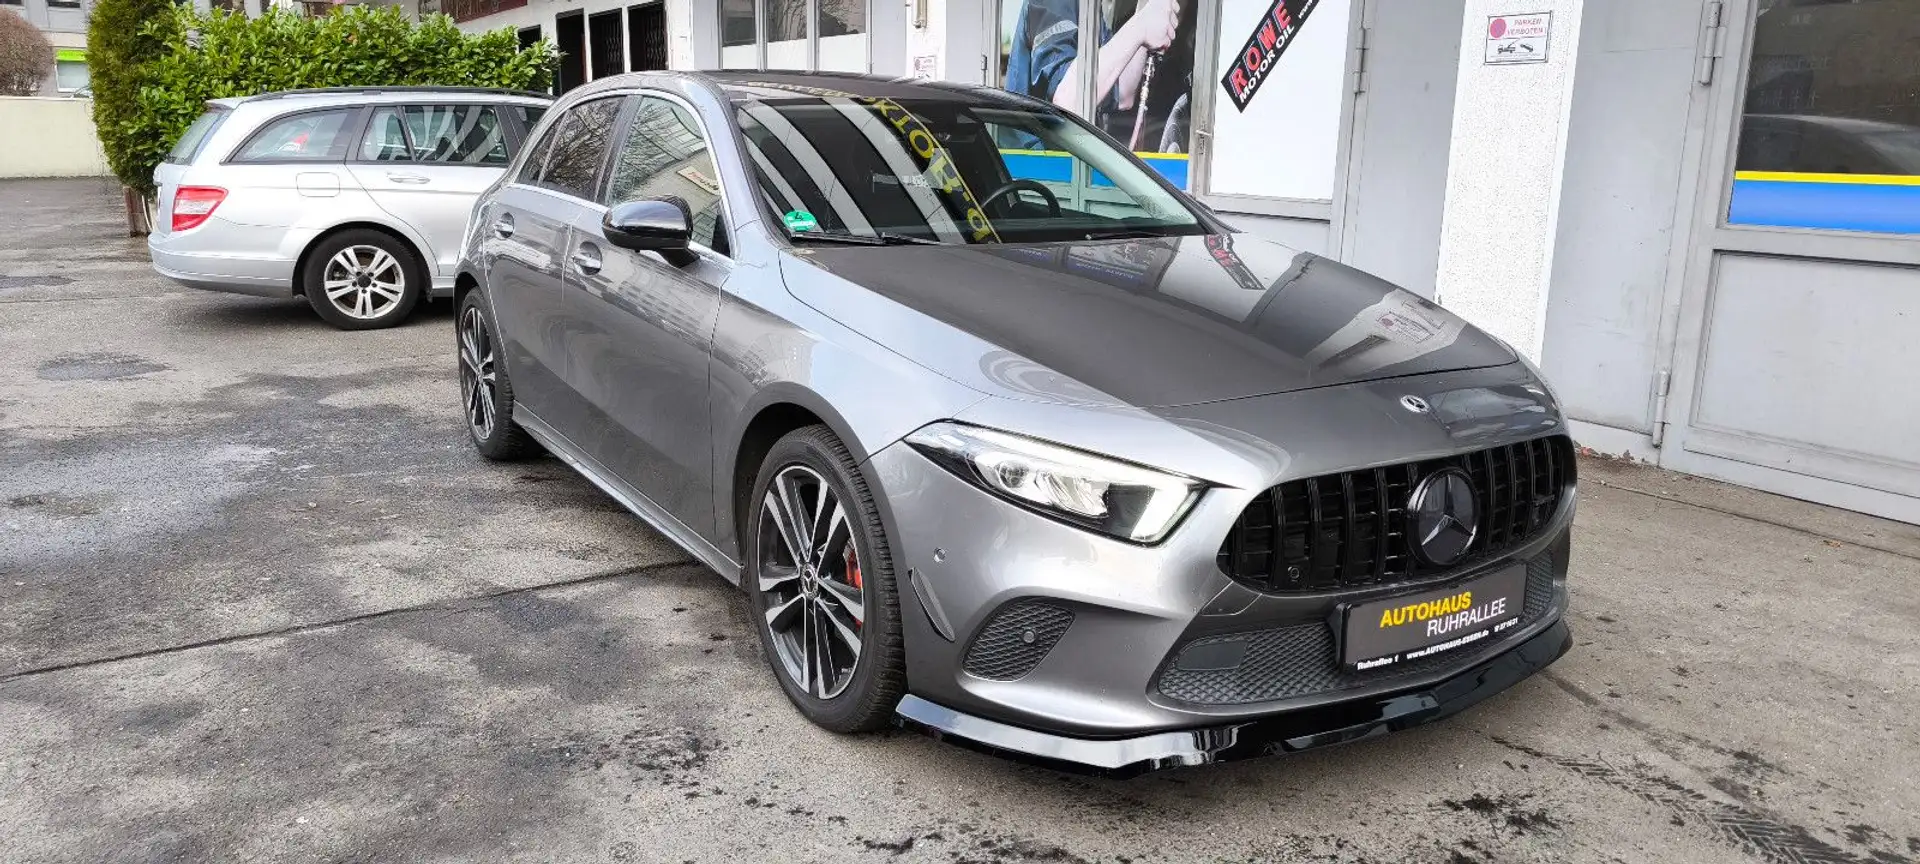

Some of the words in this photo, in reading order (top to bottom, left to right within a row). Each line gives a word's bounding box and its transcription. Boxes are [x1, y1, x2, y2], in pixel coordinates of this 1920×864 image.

[1514, 18, 1542, 26] PARKEN
[1228, 0, 1291, 98] ROWE
[1239, 49, 1276, 103] MOTOR
[1275, 25, 1295, 49] OIL
[1379, 591, 1472, 629] AUTOHAUS
[1427, 597, 1507, 637] RUHRALLEE
